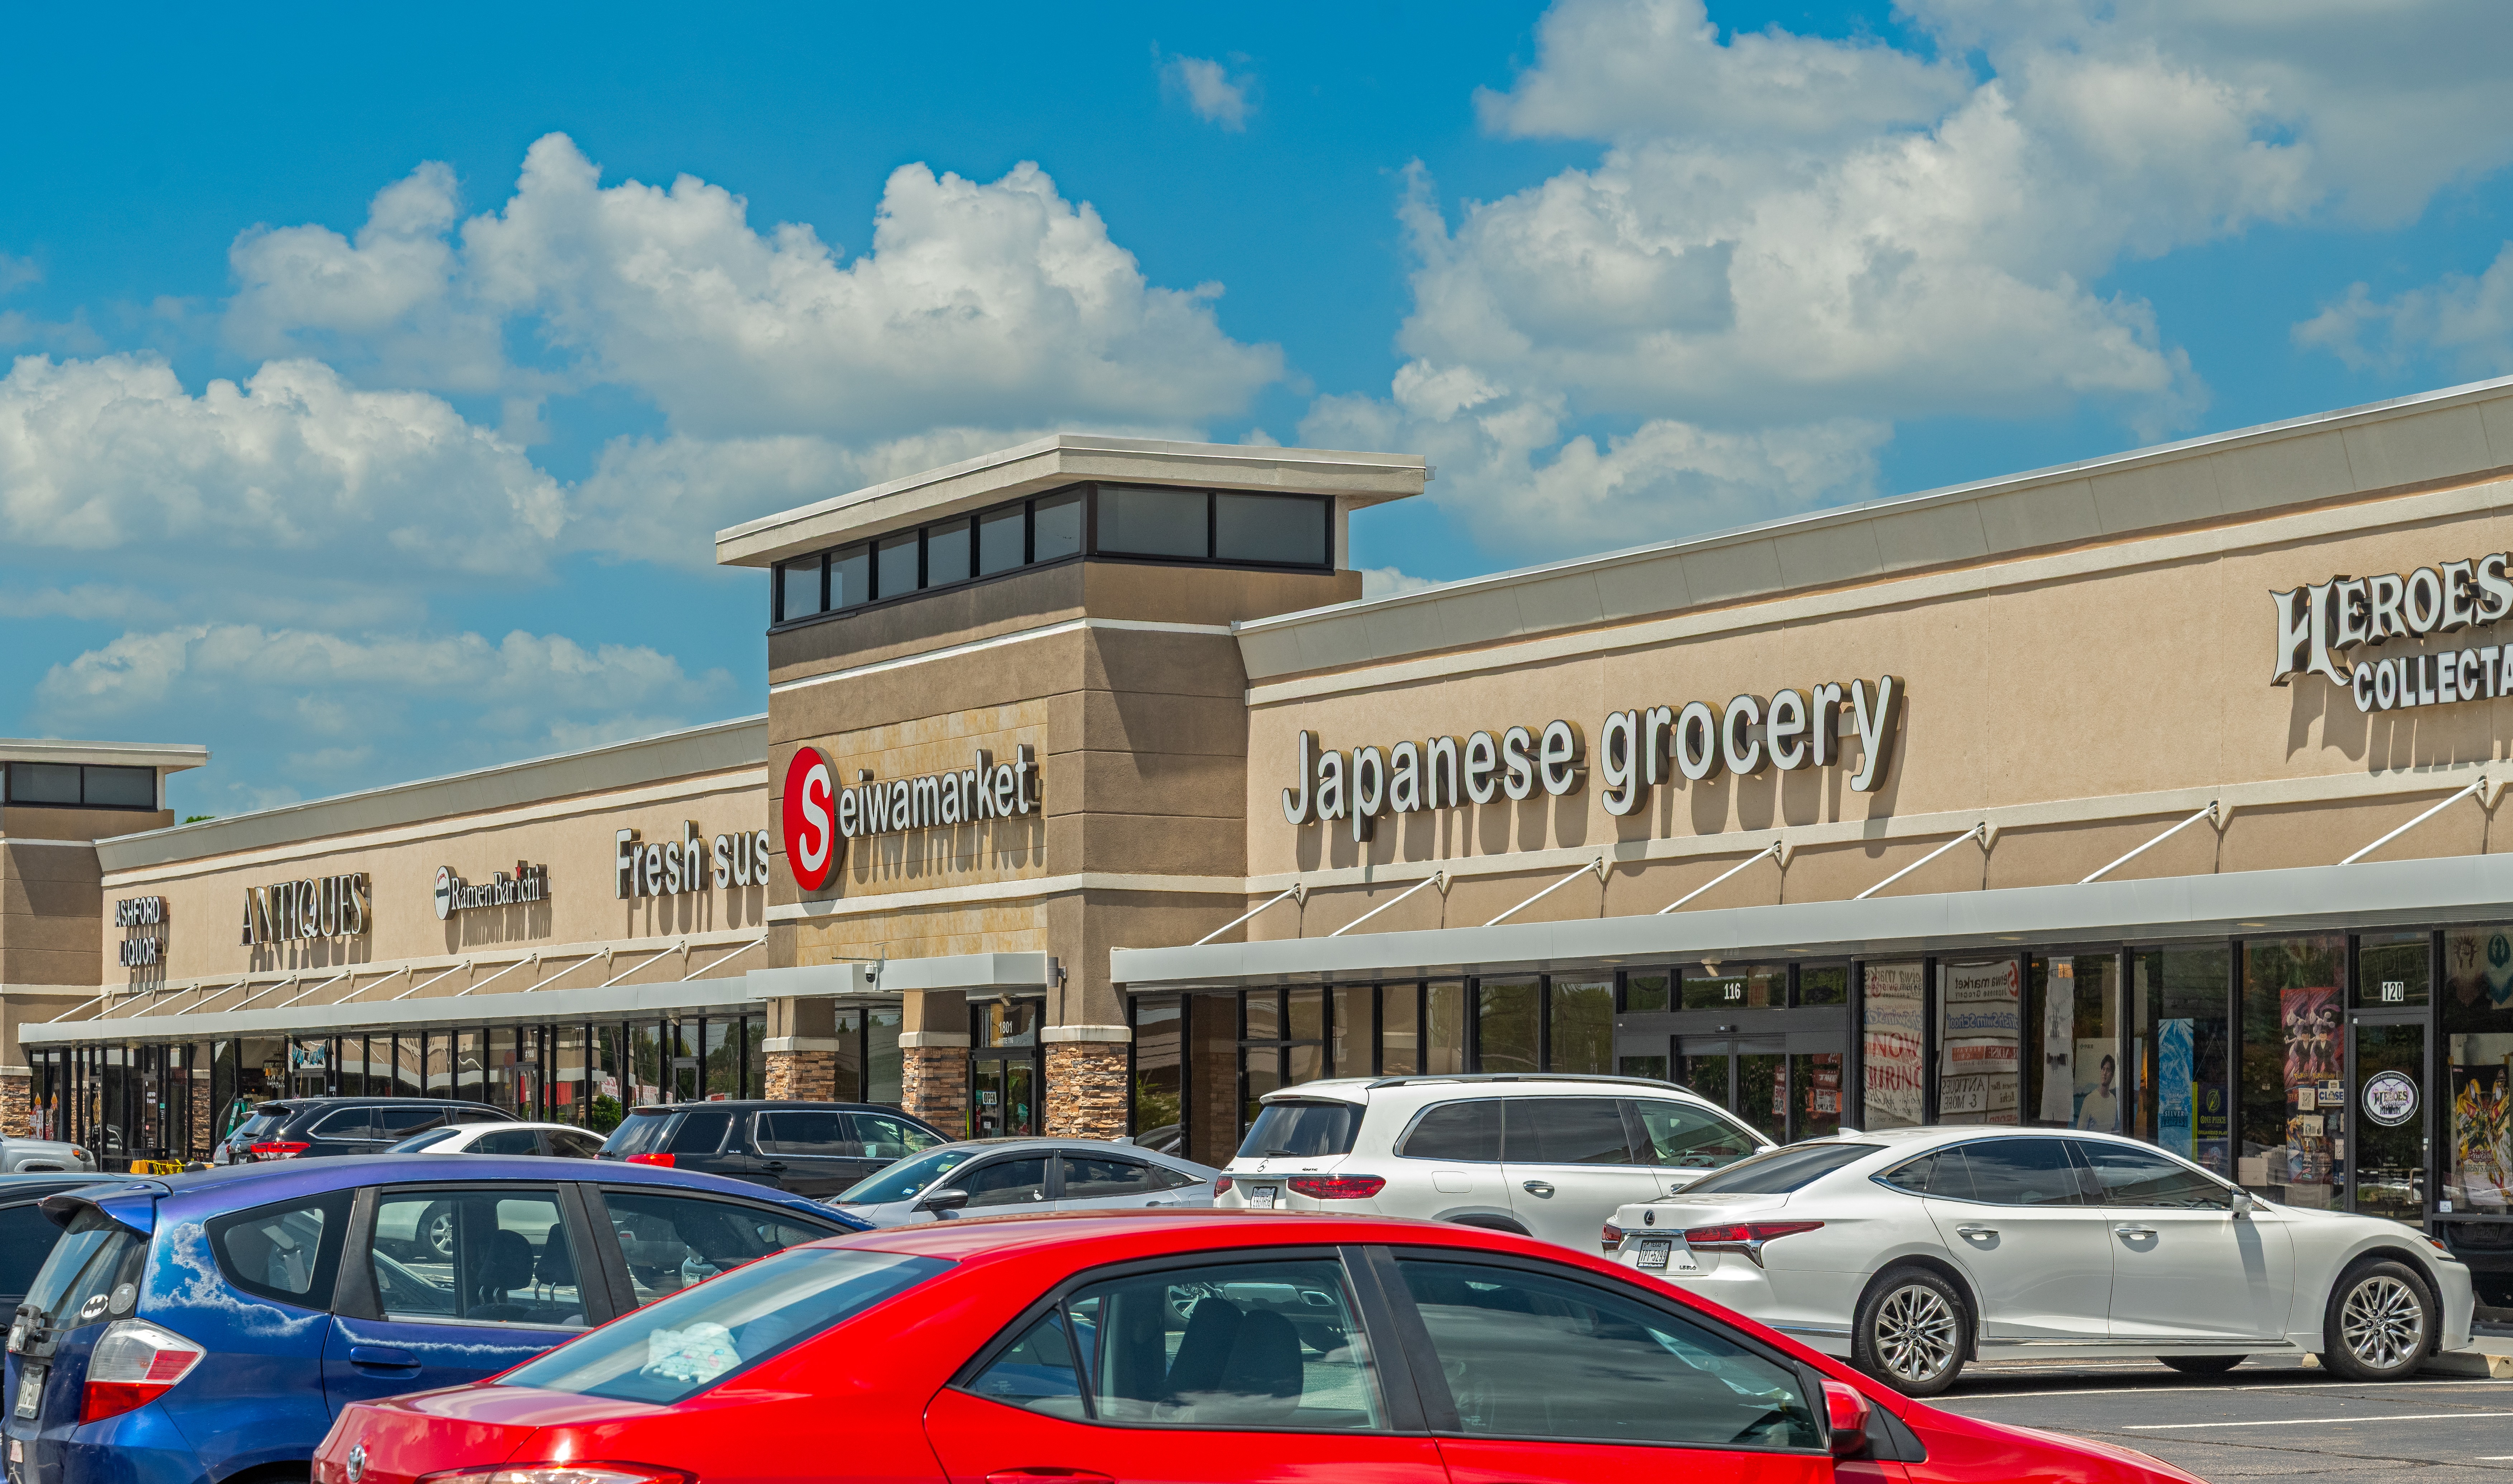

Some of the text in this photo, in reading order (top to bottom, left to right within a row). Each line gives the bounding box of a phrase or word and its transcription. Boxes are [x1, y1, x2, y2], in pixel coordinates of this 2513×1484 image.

[2269, 552, 2513, 687] HEROES
[1282, 675, 1894, 842] Japanese grocery
[616, 820, 701, 899] Fresh
[451, 876, 492, 911] Ramen
[494, 872, 515, 906] Bar
[115, 896, 160, 927] ASHFORD
[240, 872, 363, 946] ANTIQUES
[119, 937, 157, 967] LIQUOR
[1724, 982, 1741, 1000] 116
[2384, 982, 2403, 1000] 120
[999, 1021, 1013, 1034] 1801
[525, 1050, 534, 1058] #108
[1873, 1032, 1921, 1057] NOW
[984, 1093, 996, 1103] OPEN
[2373, 1091, 2408, 1107] HEROES
